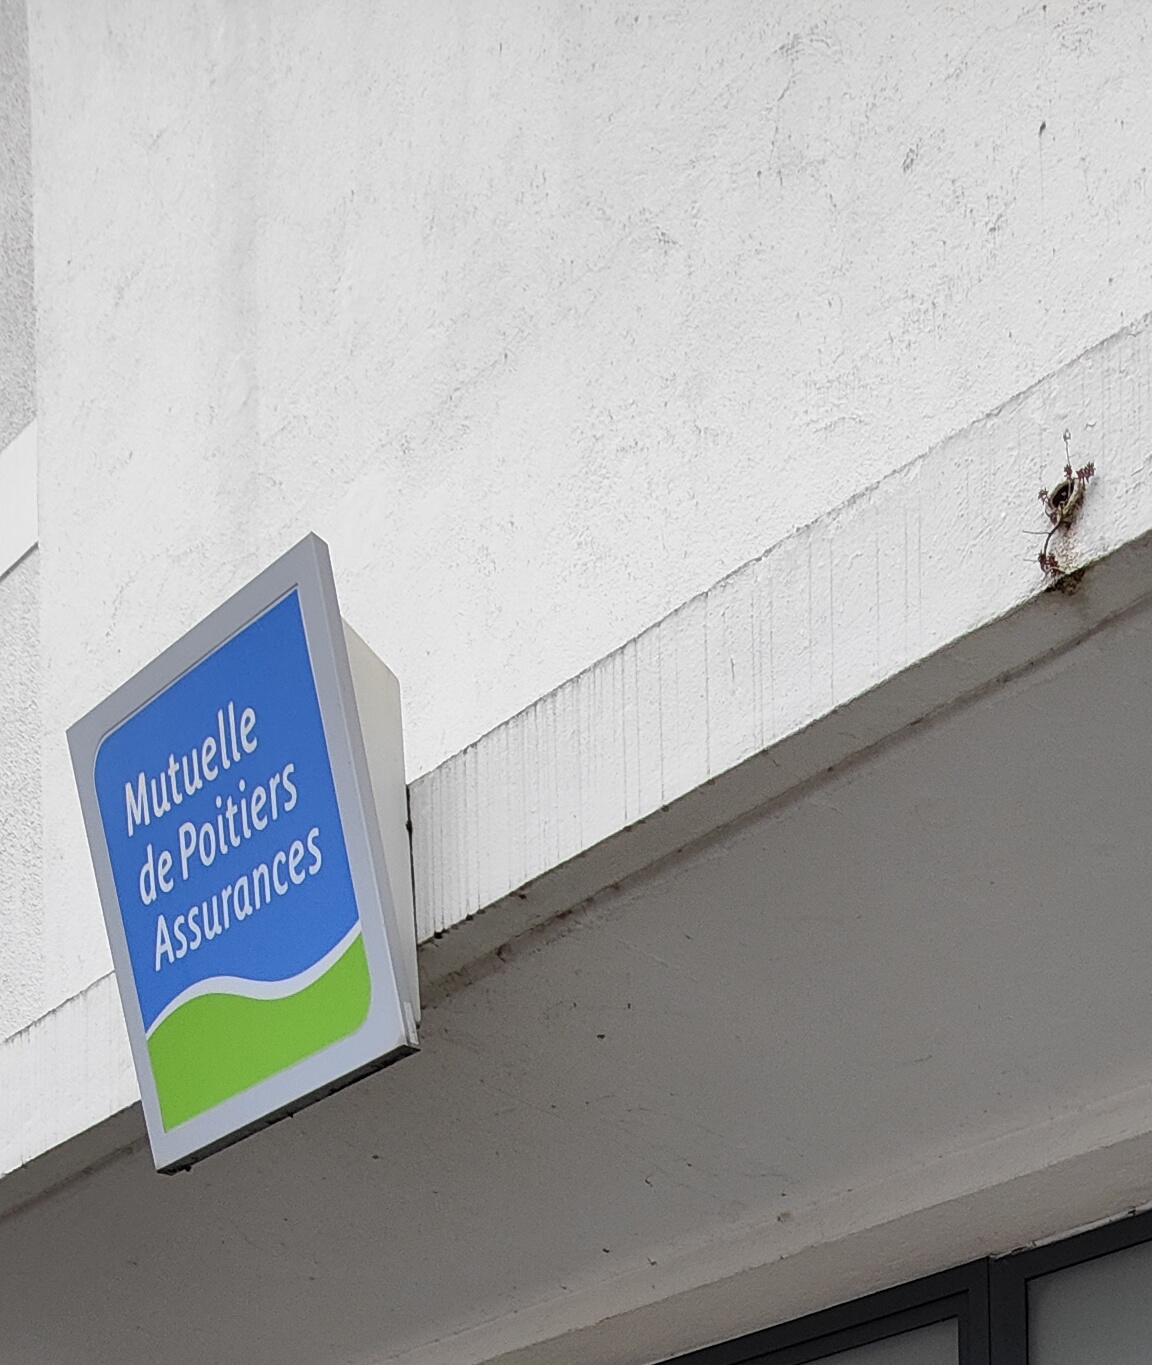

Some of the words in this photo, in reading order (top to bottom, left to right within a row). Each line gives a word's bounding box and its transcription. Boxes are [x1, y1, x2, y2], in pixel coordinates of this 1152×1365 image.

[124, 699, 259, 838] Mutuelle
[139, 844, 174, 906] de
[179, 759, 298, 882] Poitiers
[154, 826, 323, 972] Assurances
